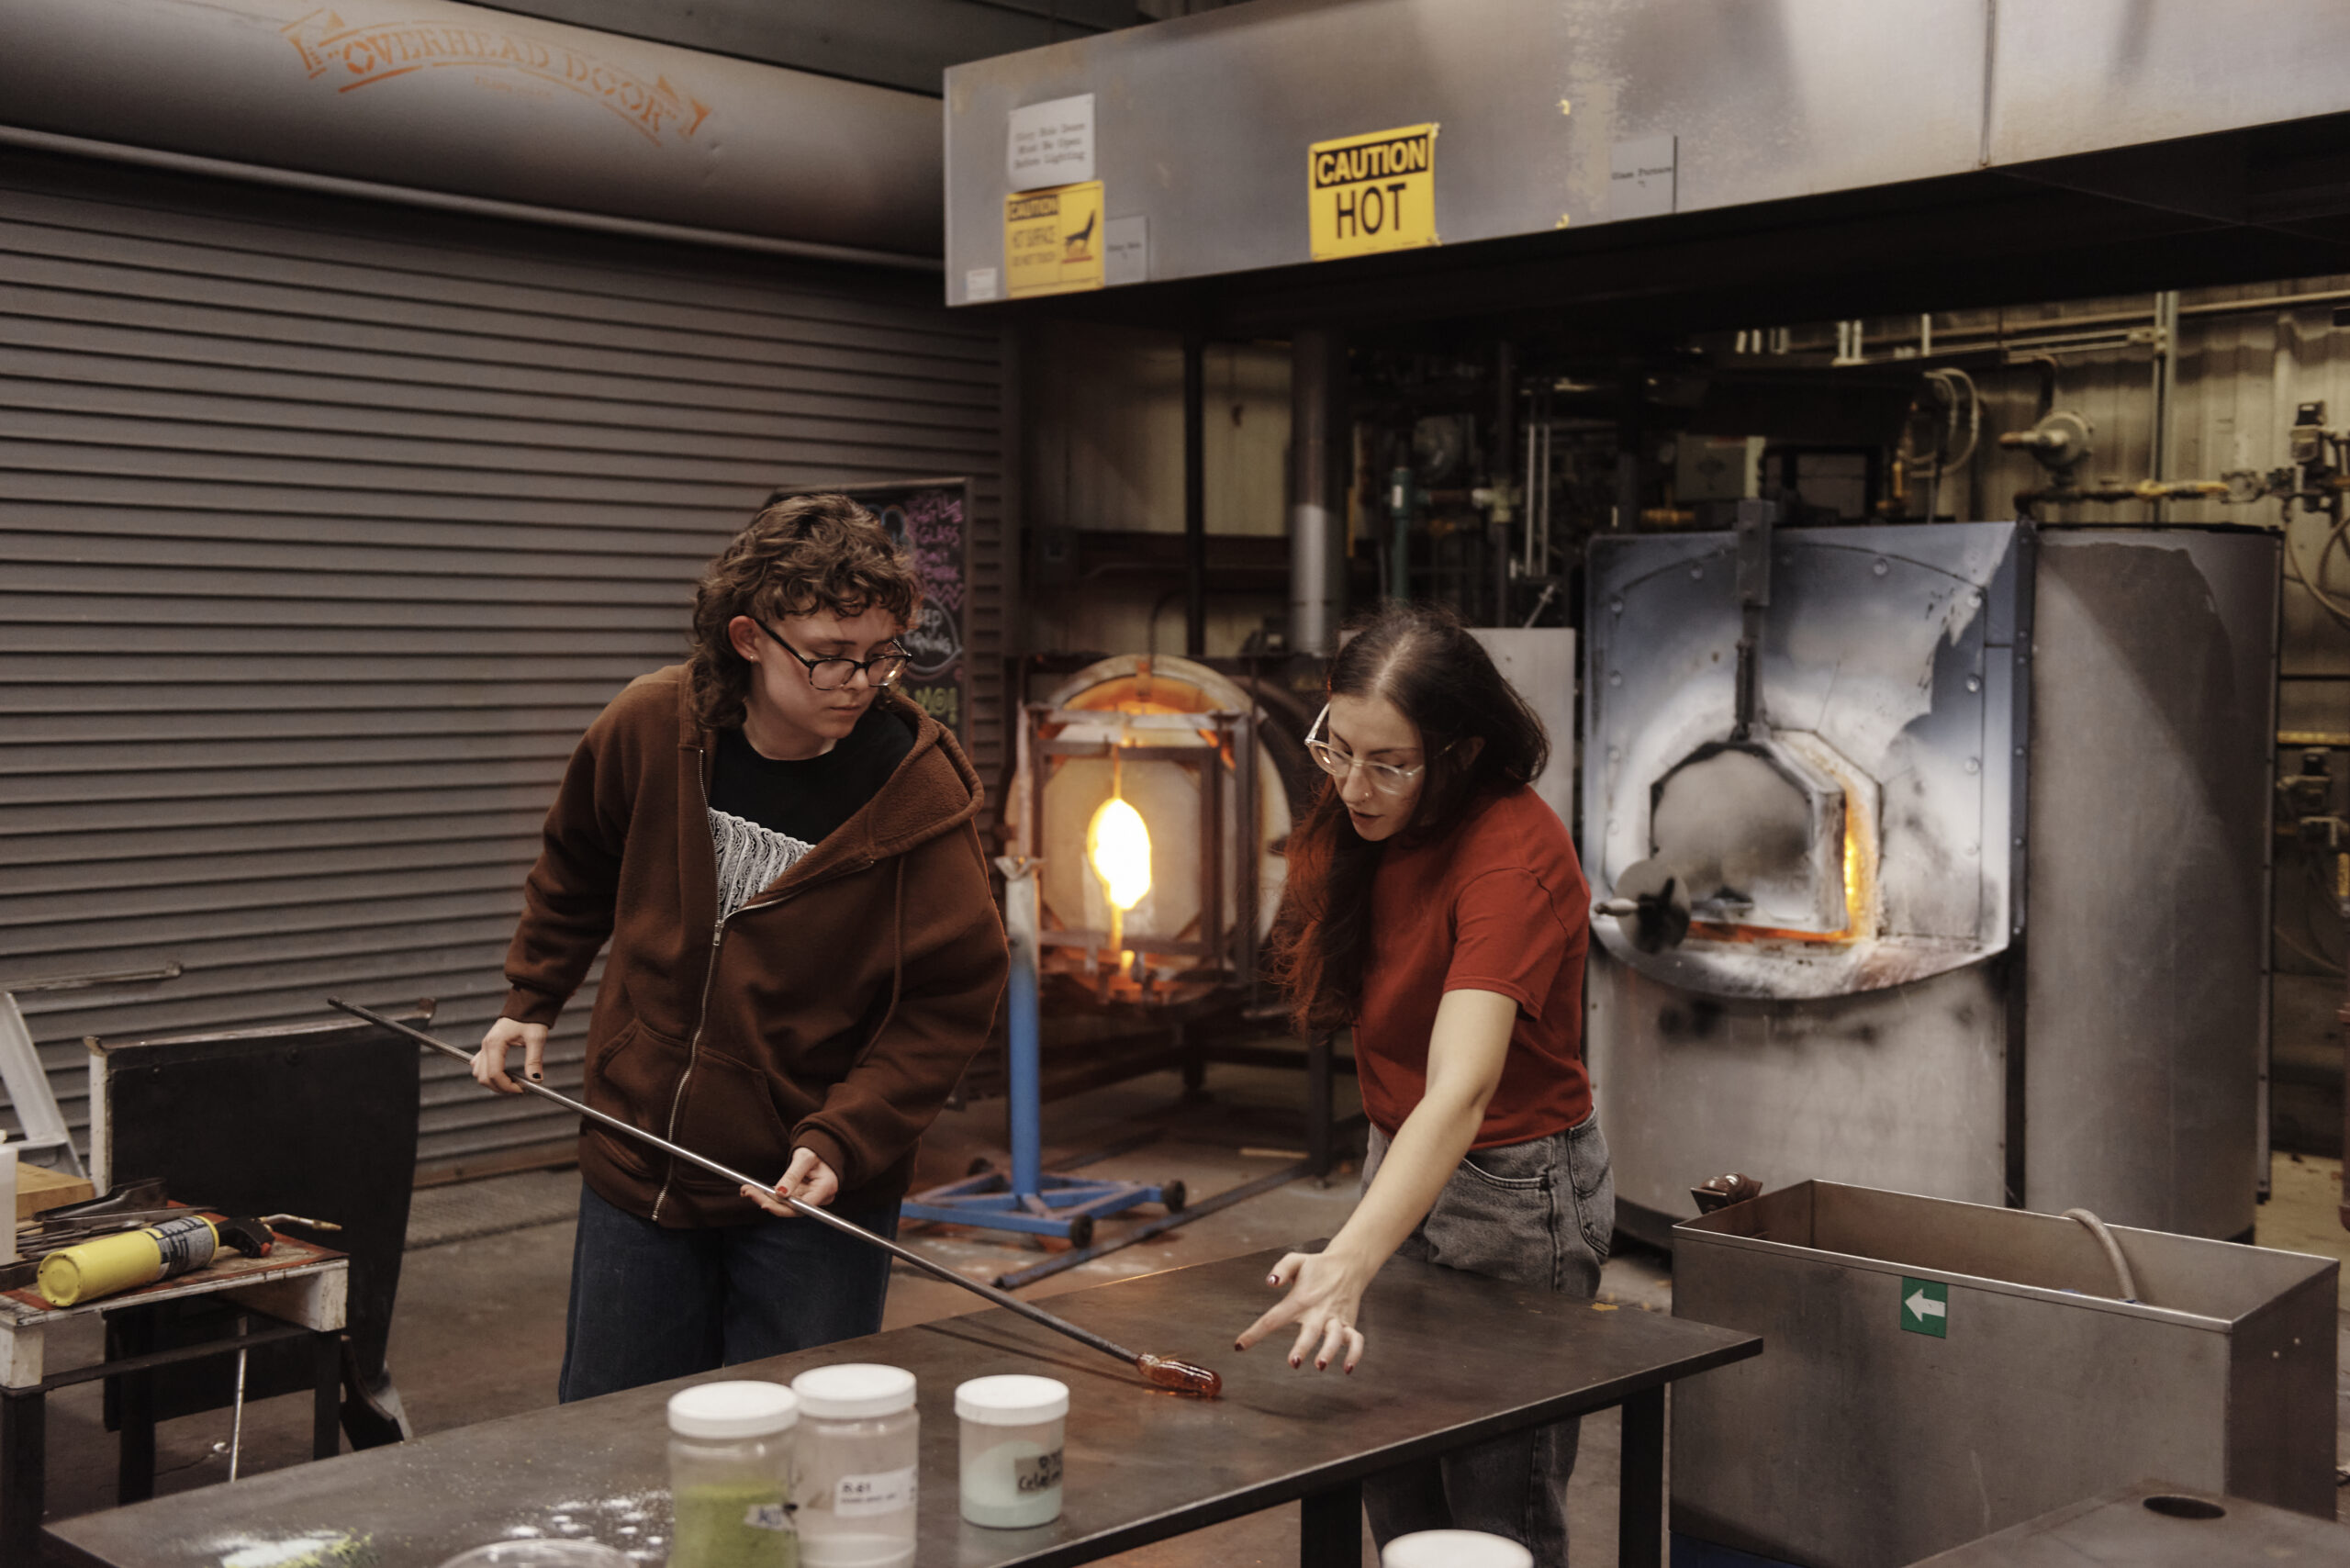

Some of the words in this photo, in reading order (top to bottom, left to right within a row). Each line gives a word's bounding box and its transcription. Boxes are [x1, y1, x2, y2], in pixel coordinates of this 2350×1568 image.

[342, 28, 549, 74] OVERHEAD
[565, 52, 664, 132] DOOR
[1316, 138, 1426, 185] CAUTION
[1337, 182, 1406, 240] HOT
